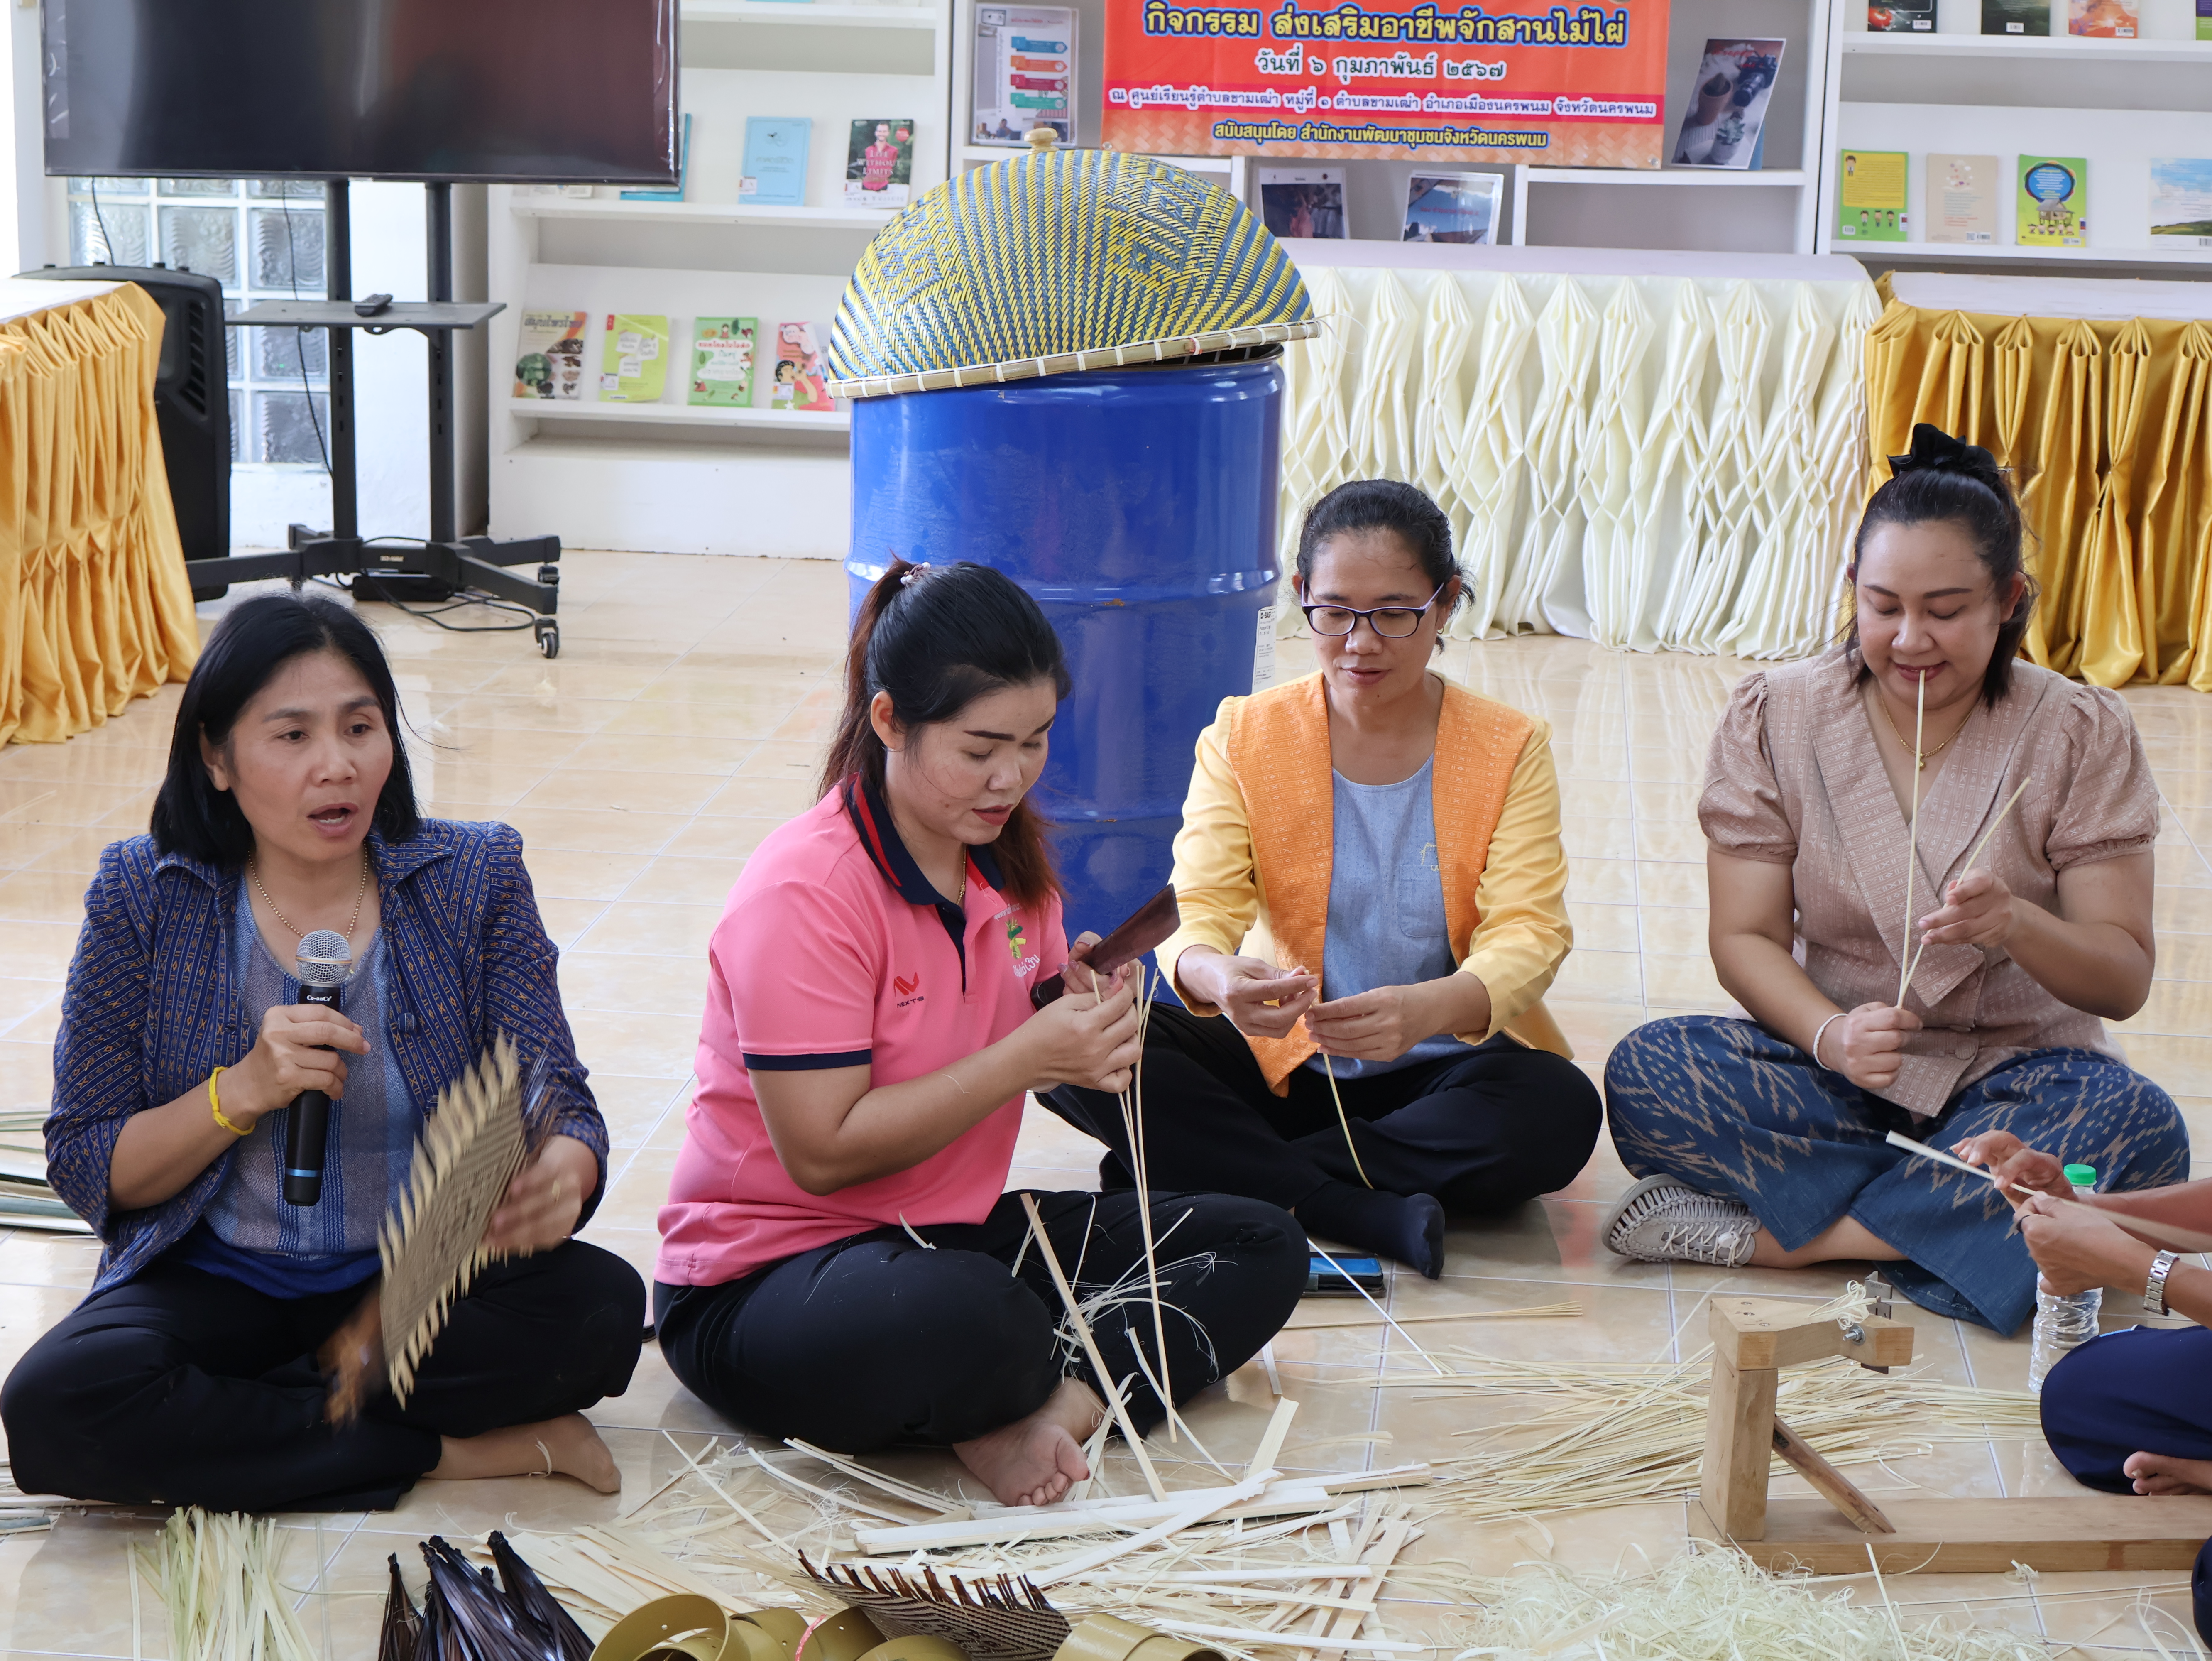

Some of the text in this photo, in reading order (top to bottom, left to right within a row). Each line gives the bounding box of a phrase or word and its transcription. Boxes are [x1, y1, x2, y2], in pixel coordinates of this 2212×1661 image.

[1146, 2, 1625, 43] กิจกรรม ส่งเสริมอาชีพจักสานไม้ไผ่
[1258, 46, 1504, 81] วันที่ ๖ กุมภาพันธ์ ๒๕๖๗
[1111, 90, 1126, 100] ณ
[1285, 88, 1314, 110] หมู่ที่
[1426, 94, 1549, 111] อำเภอเมืองนครพนม
[1556, 100, 1654, 114] จังหวัดนครพนม
[1214, 121, 1547, 147] สนับสนุนโดย สำนักงานพัฒนาชุมชนจังหวัดนครพนม
